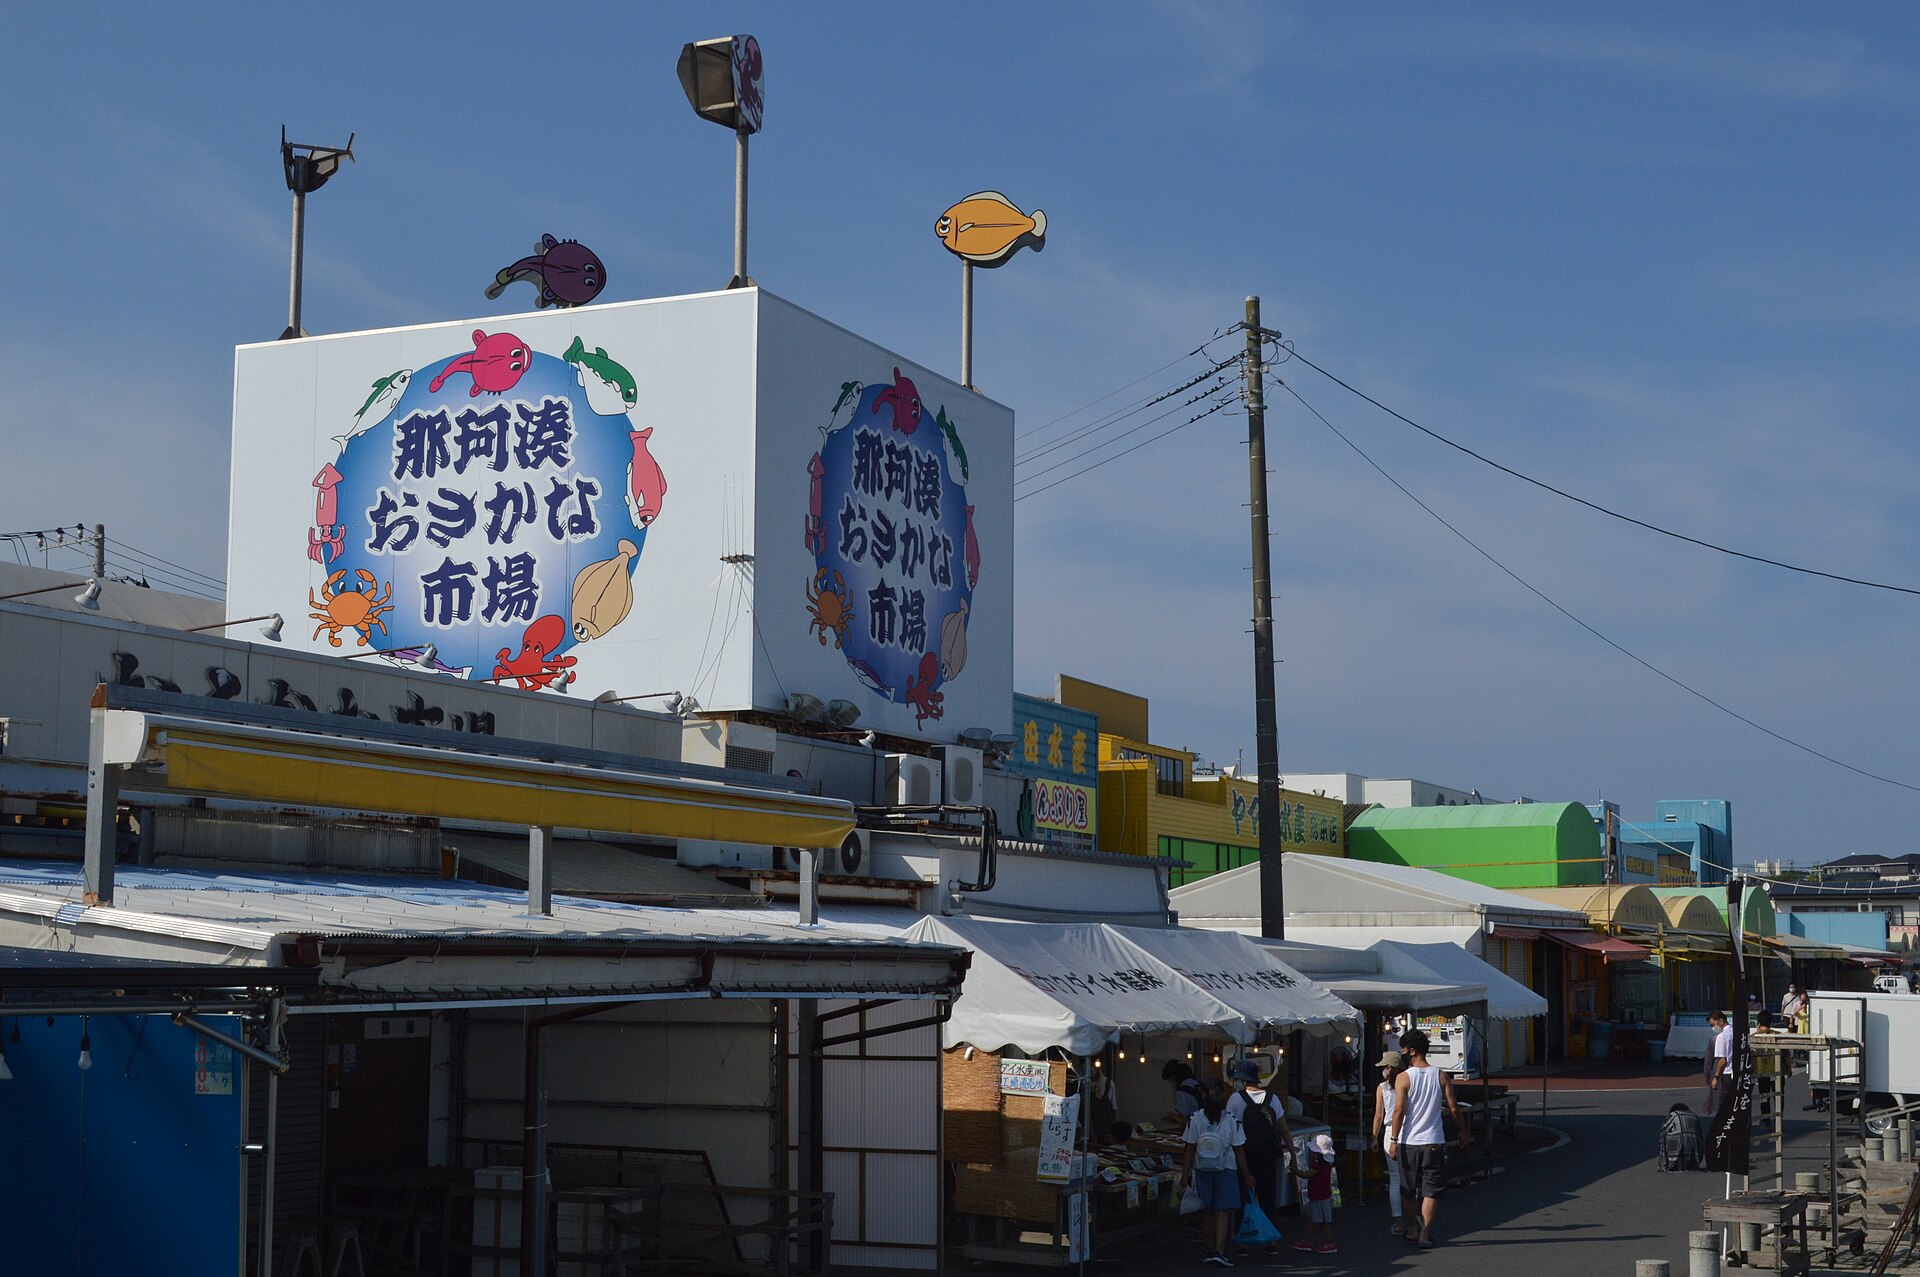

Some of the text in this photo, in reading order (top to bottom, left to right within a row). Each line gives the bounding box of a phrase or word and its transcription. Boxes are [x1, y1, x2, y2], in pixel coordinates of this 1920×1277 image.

[366, 475, 600, 552] おさかな
[839, 495, 953, 590] おさかな
[421, 552, 543, 626] 市場
[868, 578, 928, 655] 市場
[1036, 781, 1088, 829] んぶり屋
